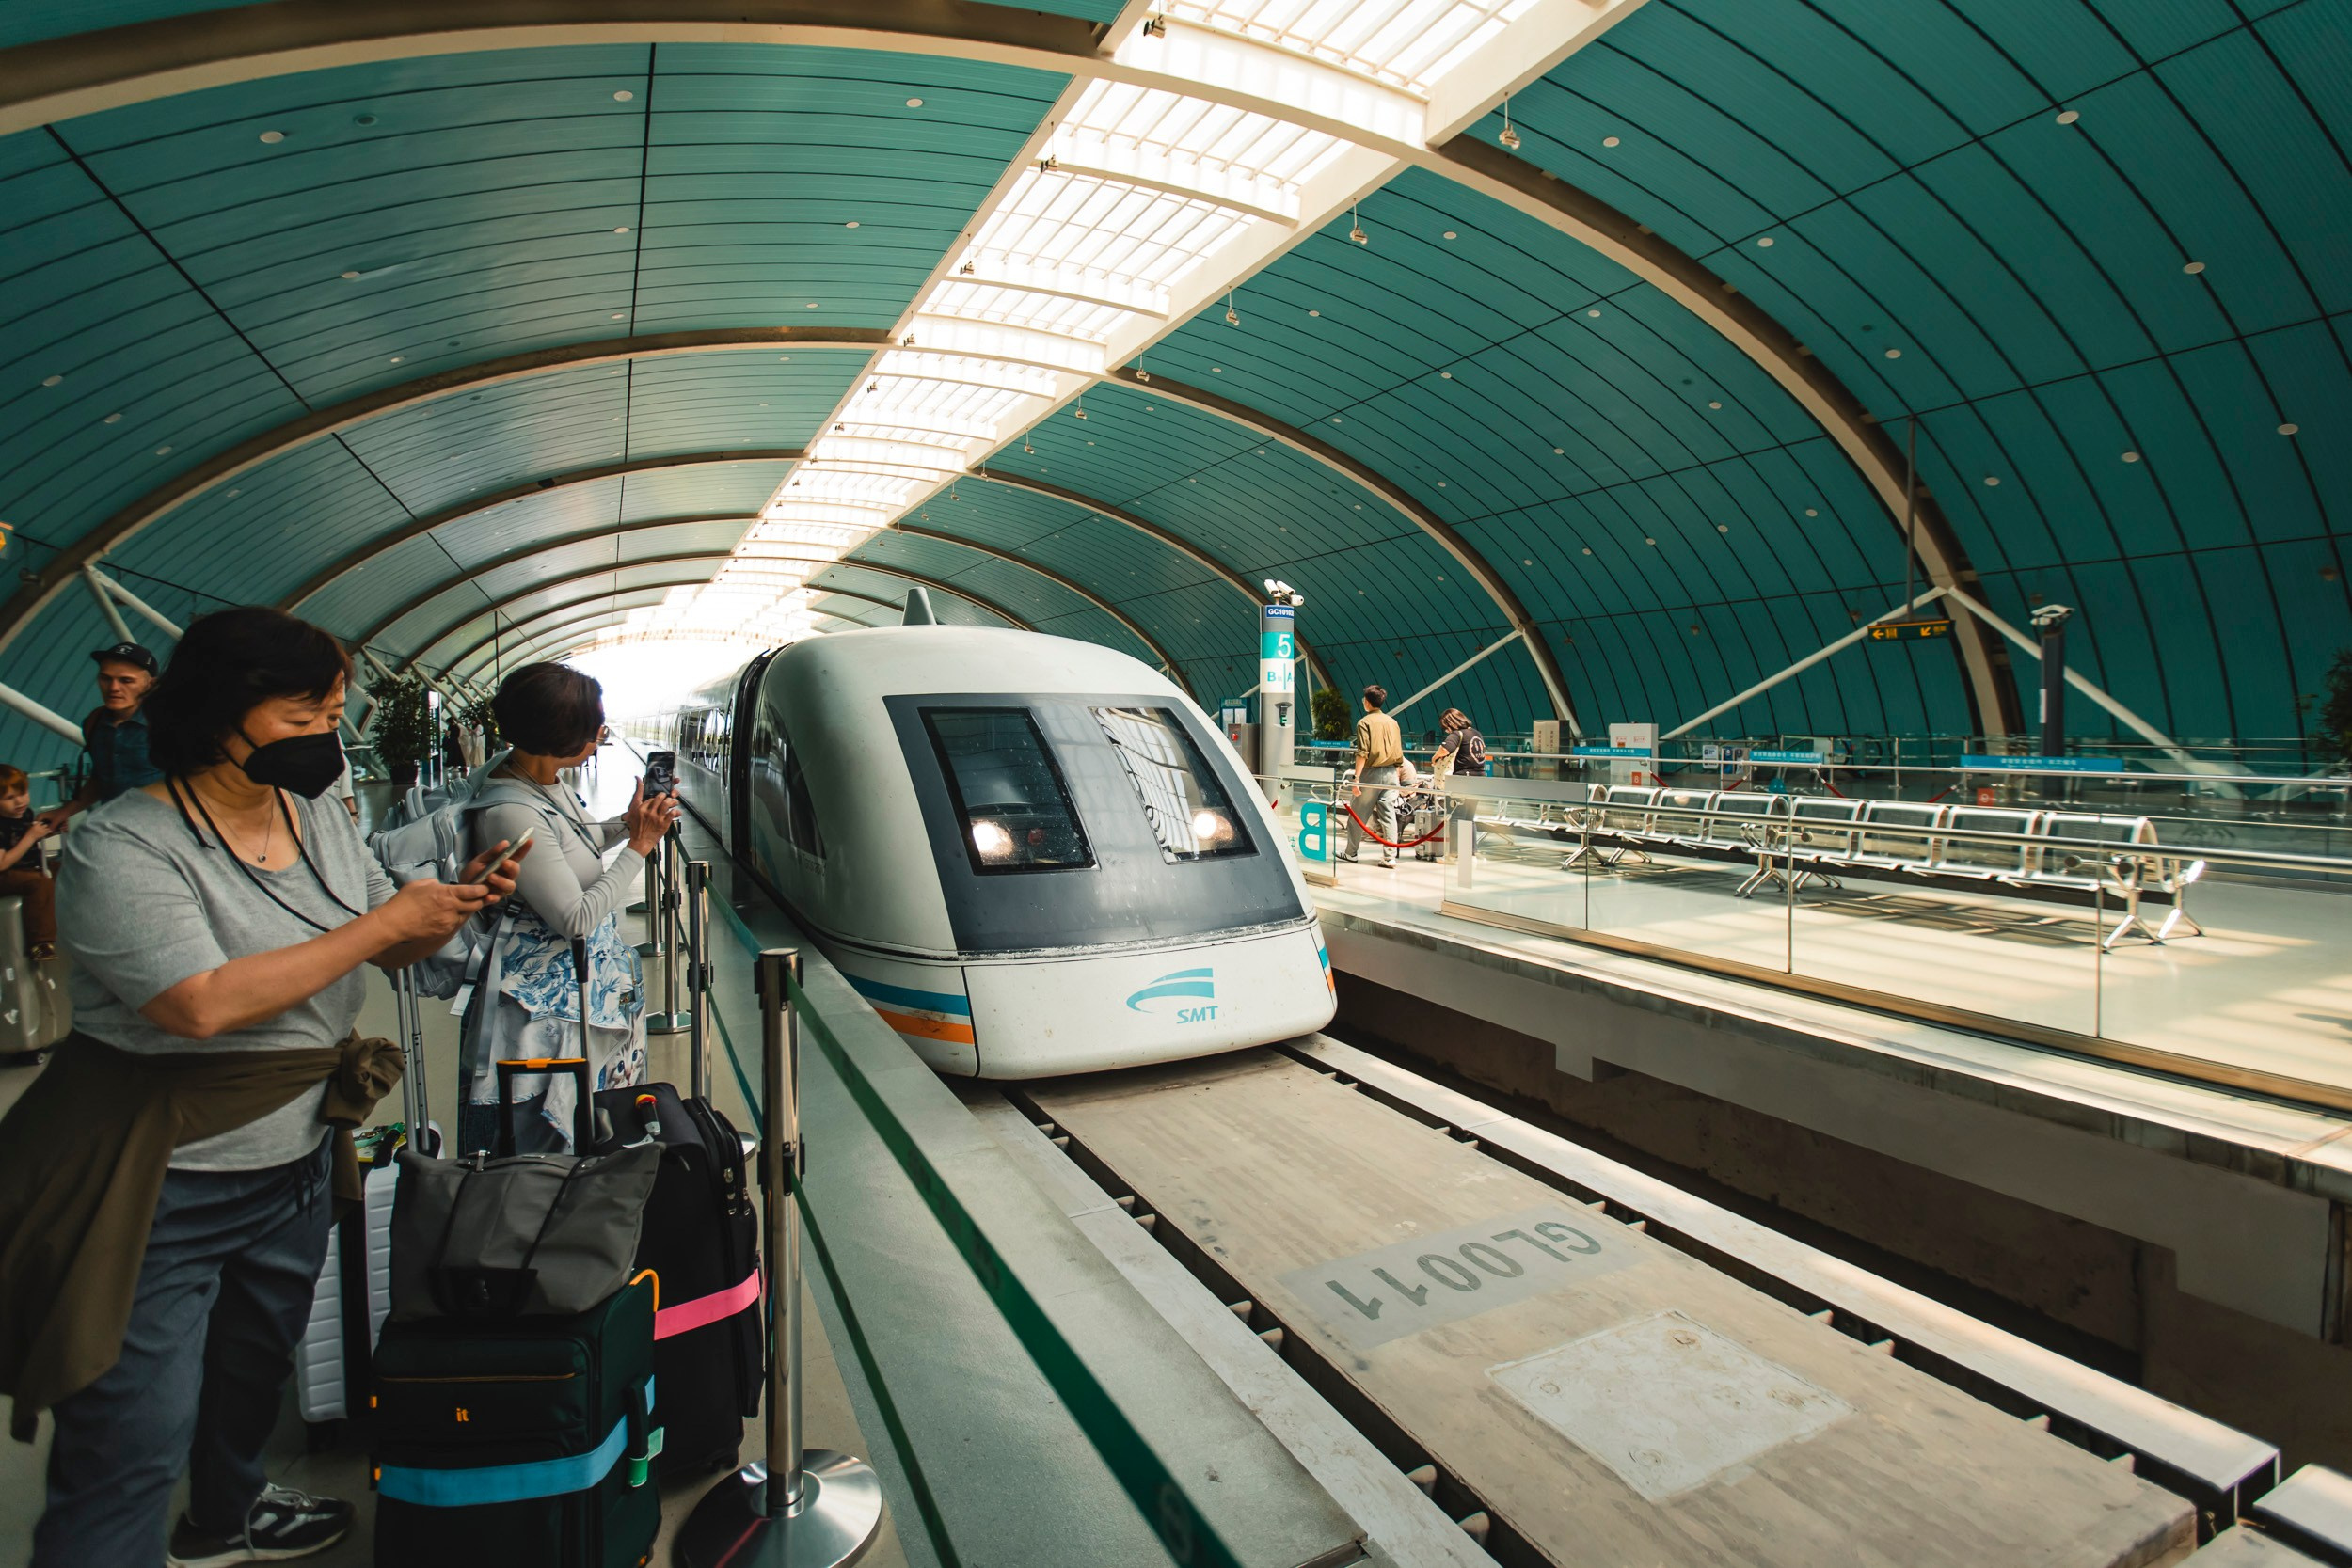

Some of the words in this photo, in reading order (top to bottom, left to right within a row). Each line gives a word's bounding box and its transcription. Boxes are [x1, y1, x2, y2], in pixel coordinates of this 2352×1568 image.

[1278, 633, 1292, 658] 5
[1267, 671, 1277, 682] B
[1176, 1006, 1219, 1024] SMT
[1325, 1221, 1602, 1321] GL0011
[456, 1407, 469, 1422] it
